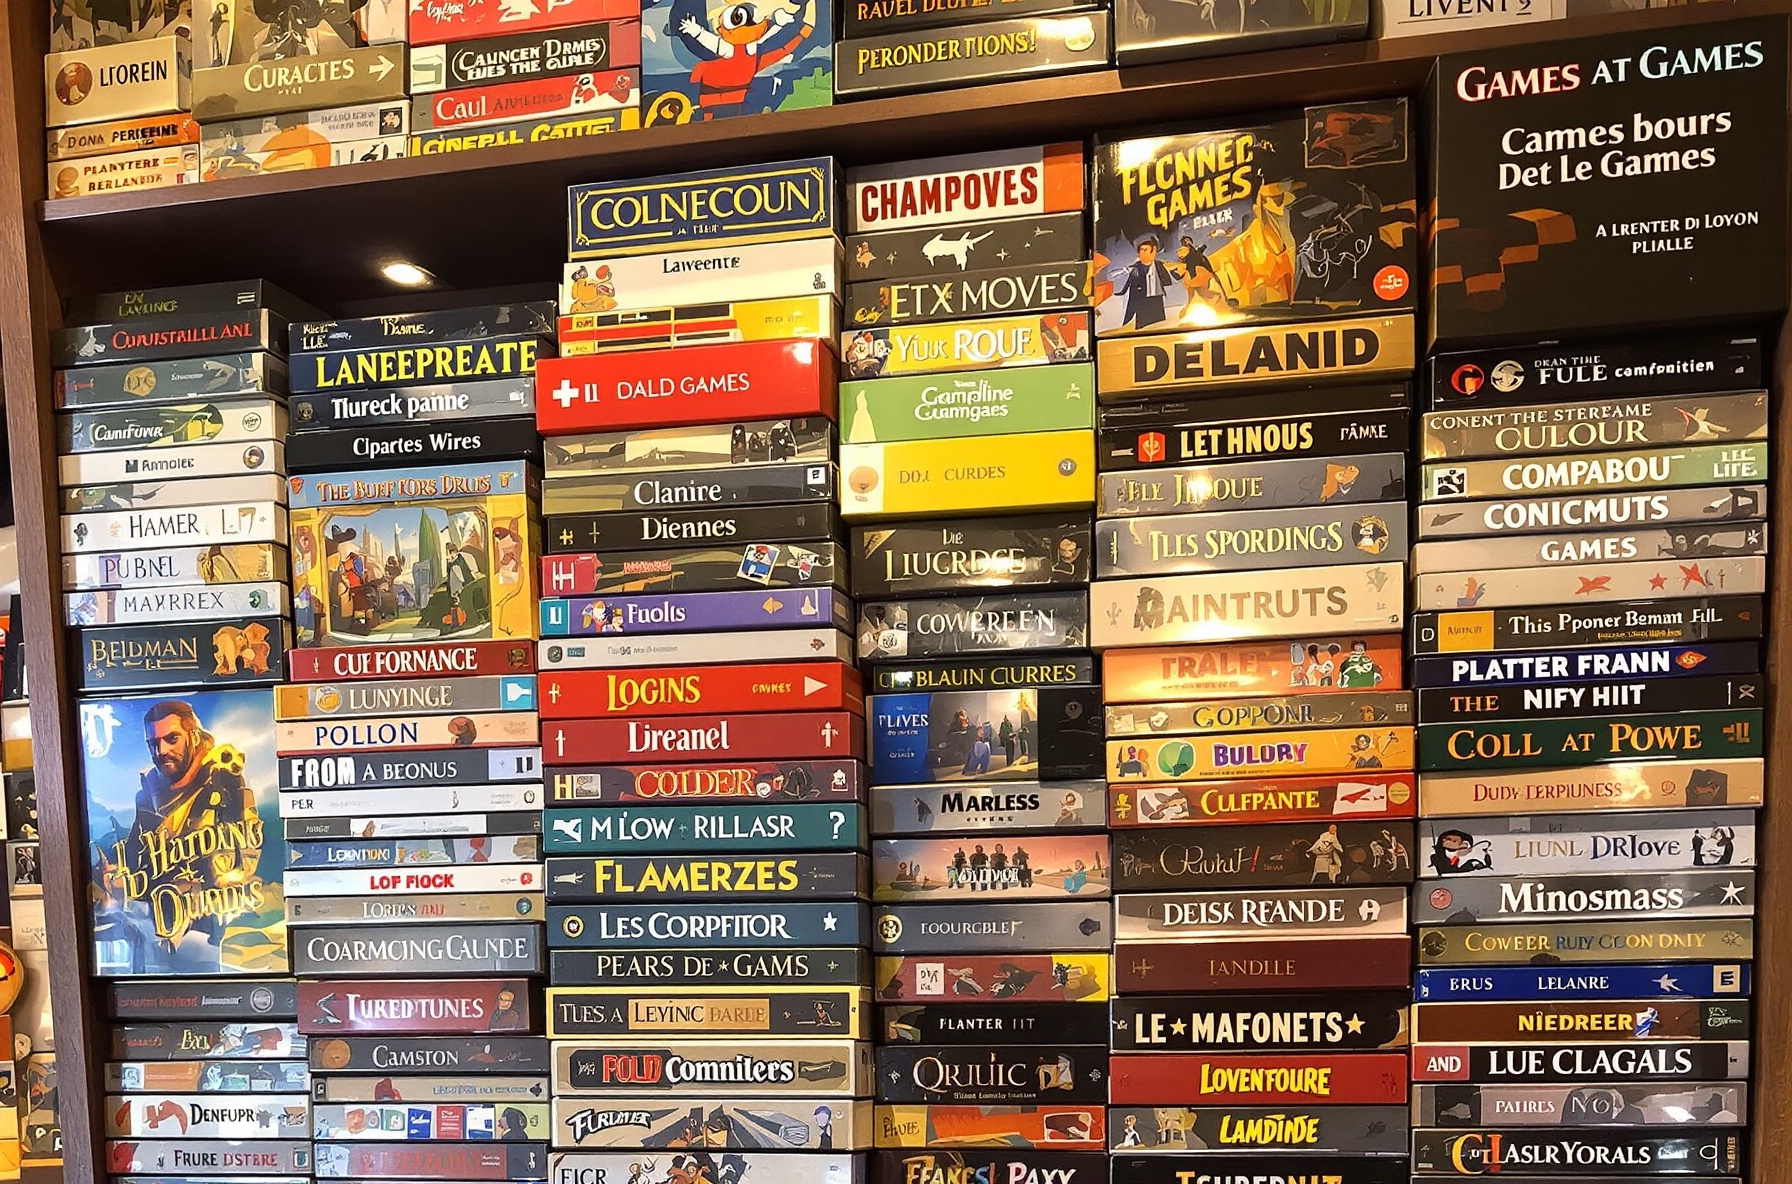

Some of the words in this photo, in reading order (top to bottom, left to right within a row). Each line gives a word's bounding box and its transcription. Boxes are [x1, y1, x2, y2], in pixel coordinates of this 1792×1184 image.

[243, 58, 354, 92] CURACTES
[1456, 63, 1581, 102] GAMES
[1592, 58, 1631, 85] AT
[1639, 40, 1764, 79] GAMES
[1633, 110, 1732, 143] bours
[1499, 162, 1552, 190] Det
[1560, 153, 1592, 183] Le
[591, 179, 810, 230] COLNECOUN
[862, 166, 1038, 223] CHAMPOVES
[1147, 166, 1252, 229] GAMES
[1596, 224, 1607, 237] A
[962, 272, 1078, 312] MOVES
[617, 378, 675, 399] DALD
[679, 372, 750, 395] GAMES
[429, 433, 481, 451] Wires
[640, 516, 737, 540] Diennes
[1541, 537, 1638, 562] GAMES
[1509, 615, 1552, 636] This
[1452, 655, 1570, 682] PLATTER
[1578, 651, 1671, 677] FRANN
[607, 674, 701, 711] LOGINS
[1450, 695, 1500, 713] THE
[315, 722, 418, 746] POLLON
[1448, 729, 1542, 760] COLL
[1561, 732, 1595, 751] AT
[362, 763, 377, 781] A
[941, 792, 1040, 814] MARLESS
[595, 860, 799, 893] FLAMERZES
[1498, 883, 1684, 914] Minosmass
[600, 912, 644, 939] LES
[597, 955, 674, 977] PEARS
[1135, 1013, 1167, 1044] LE
[1192, 1011, 1343, 1044] MAFONETS
[1426, 1055, 1461, 1072] AND
[1488, 1049, 1545, 1075] LUE
